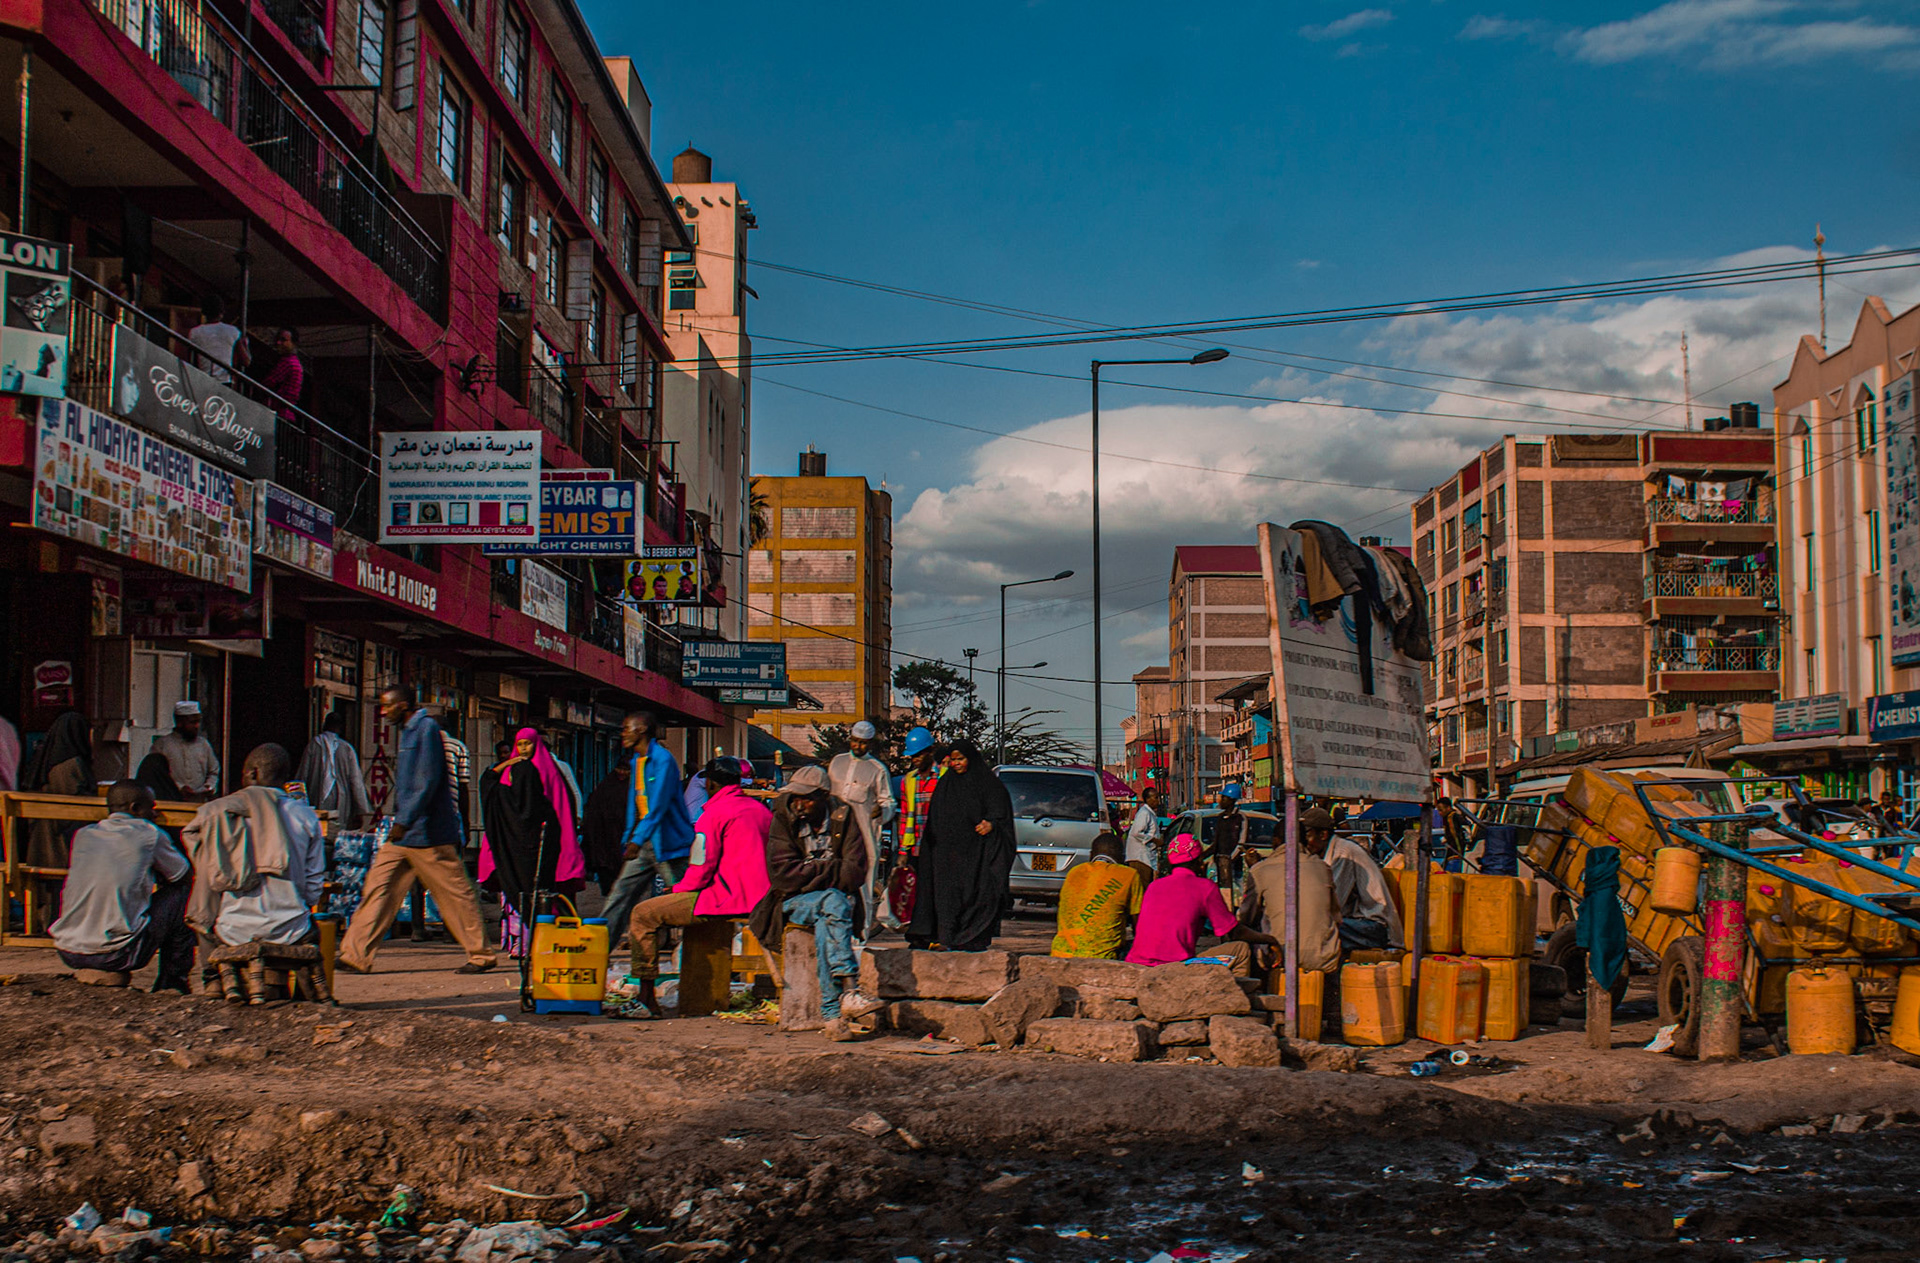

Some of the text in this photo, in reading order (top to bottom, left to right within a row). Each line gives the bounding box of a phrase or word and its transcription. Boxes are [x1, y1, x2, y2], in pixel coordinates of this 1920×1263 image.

[149, 365, 263, 452] Ever Blazin
[65, 402, 84, 445] AL
[88, 411, 139, 467] HIDAYA
[143, 436, 195, 491] GENERAL
[420, 440, 440, 456] بن
[442, 436, 481, 455] نعمان
[484, 436, 532, 456] مدرسة
[160, 480, 221, 518] 0722 135 307
[525, 541, 567, 551] NIGHT
[570, 541, 632, 551] CHEMIST
[678, 547, 696, 558] SHOP
[357, 559, 397, 598] White
[683, 642, 741, 659] AL-HIDDAYA
[1890, 693, 1906, 704] THE
[1080, 877, 1124, 924] ARMANI
